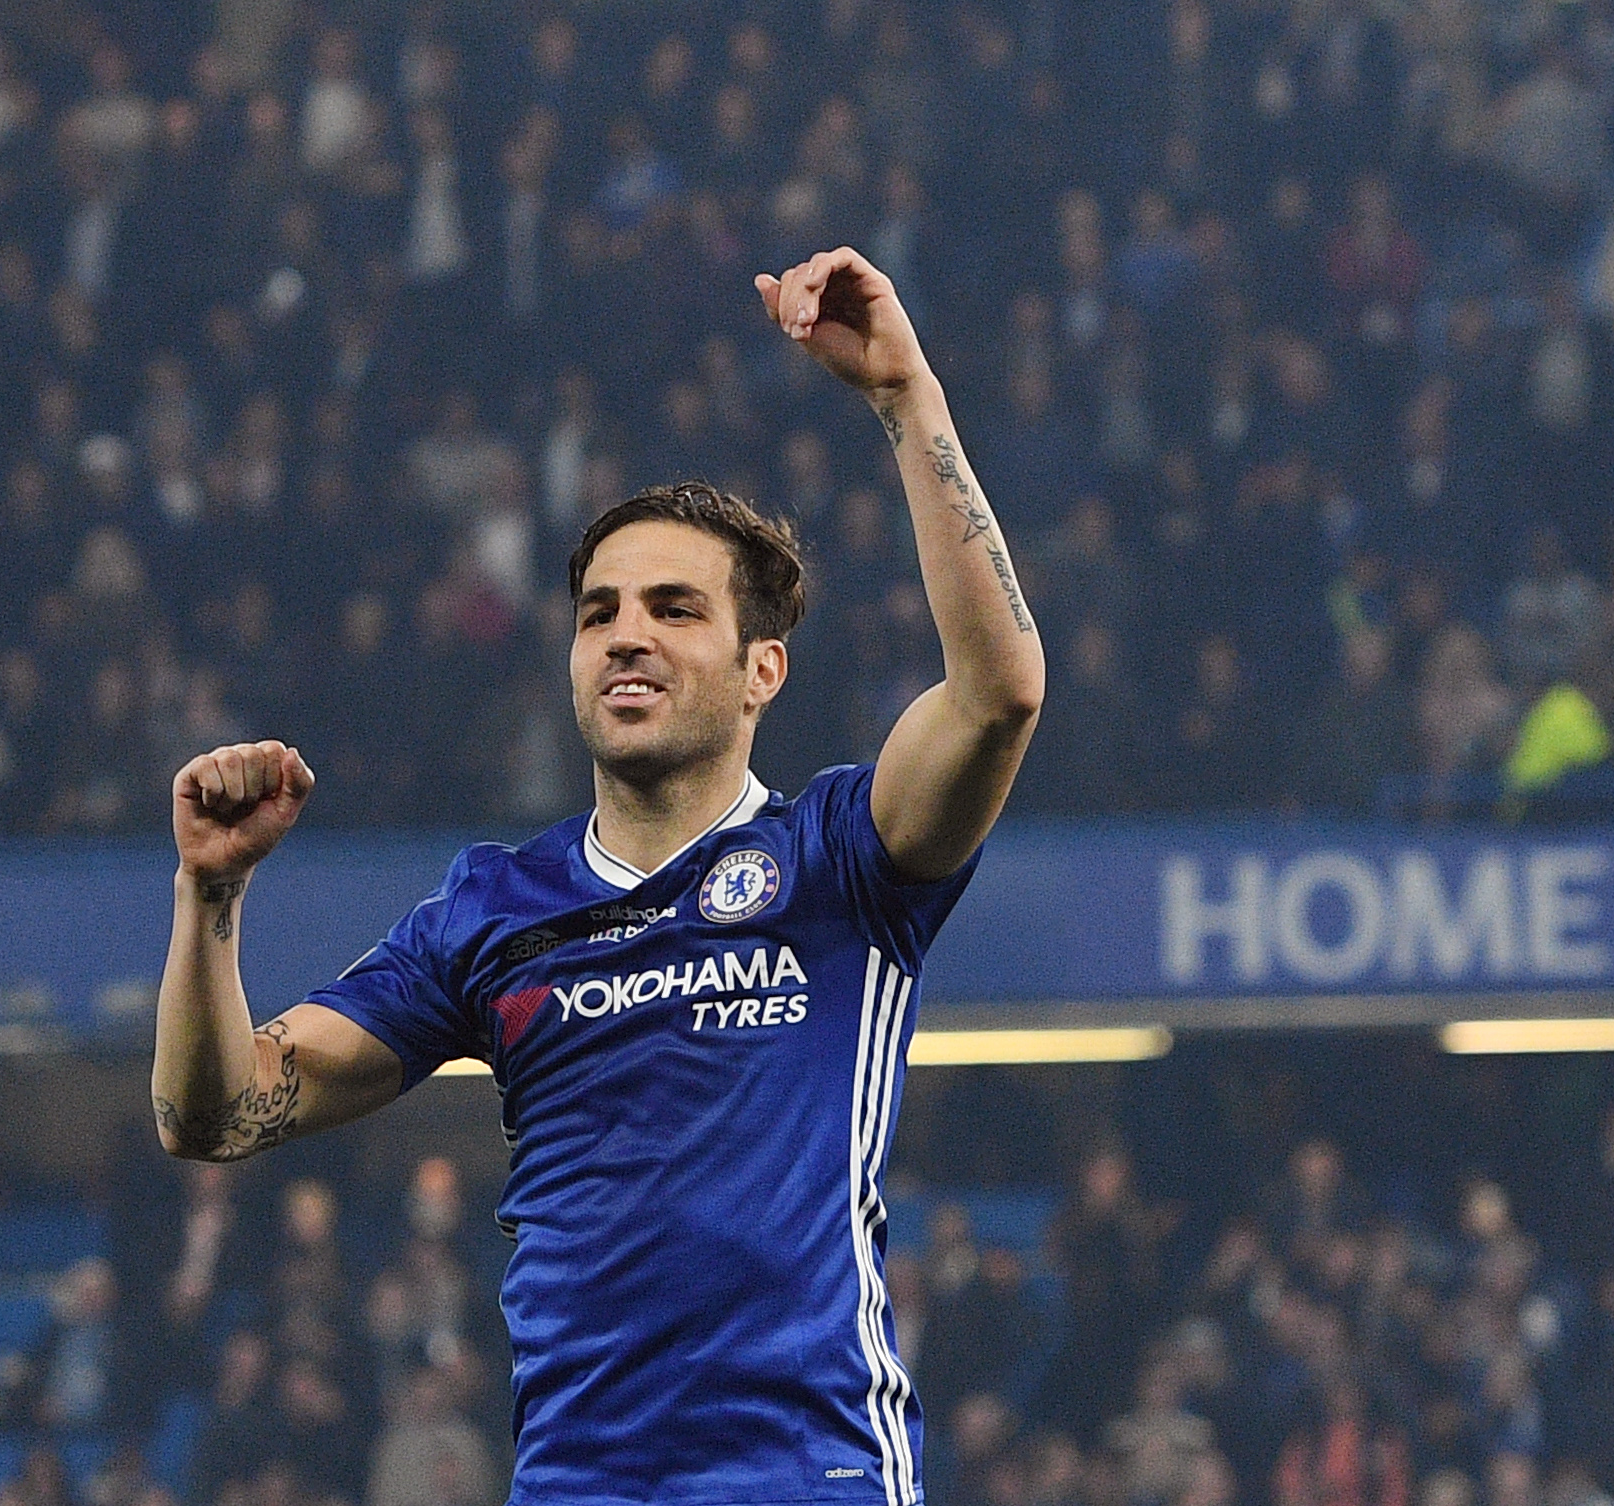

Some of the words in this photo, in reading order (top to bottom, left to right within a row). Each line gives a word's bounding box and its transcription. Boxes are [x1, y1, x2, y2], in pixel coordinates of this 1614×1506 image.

[714, 853, 765, 876] CHELSEA
[1160, 844, 1614, 984] HOME
[506, 939, 566, 960] adida
[552, 946, 809, 1023] YOKOHAMA
[691, 994, 809, 1032] TYRES
